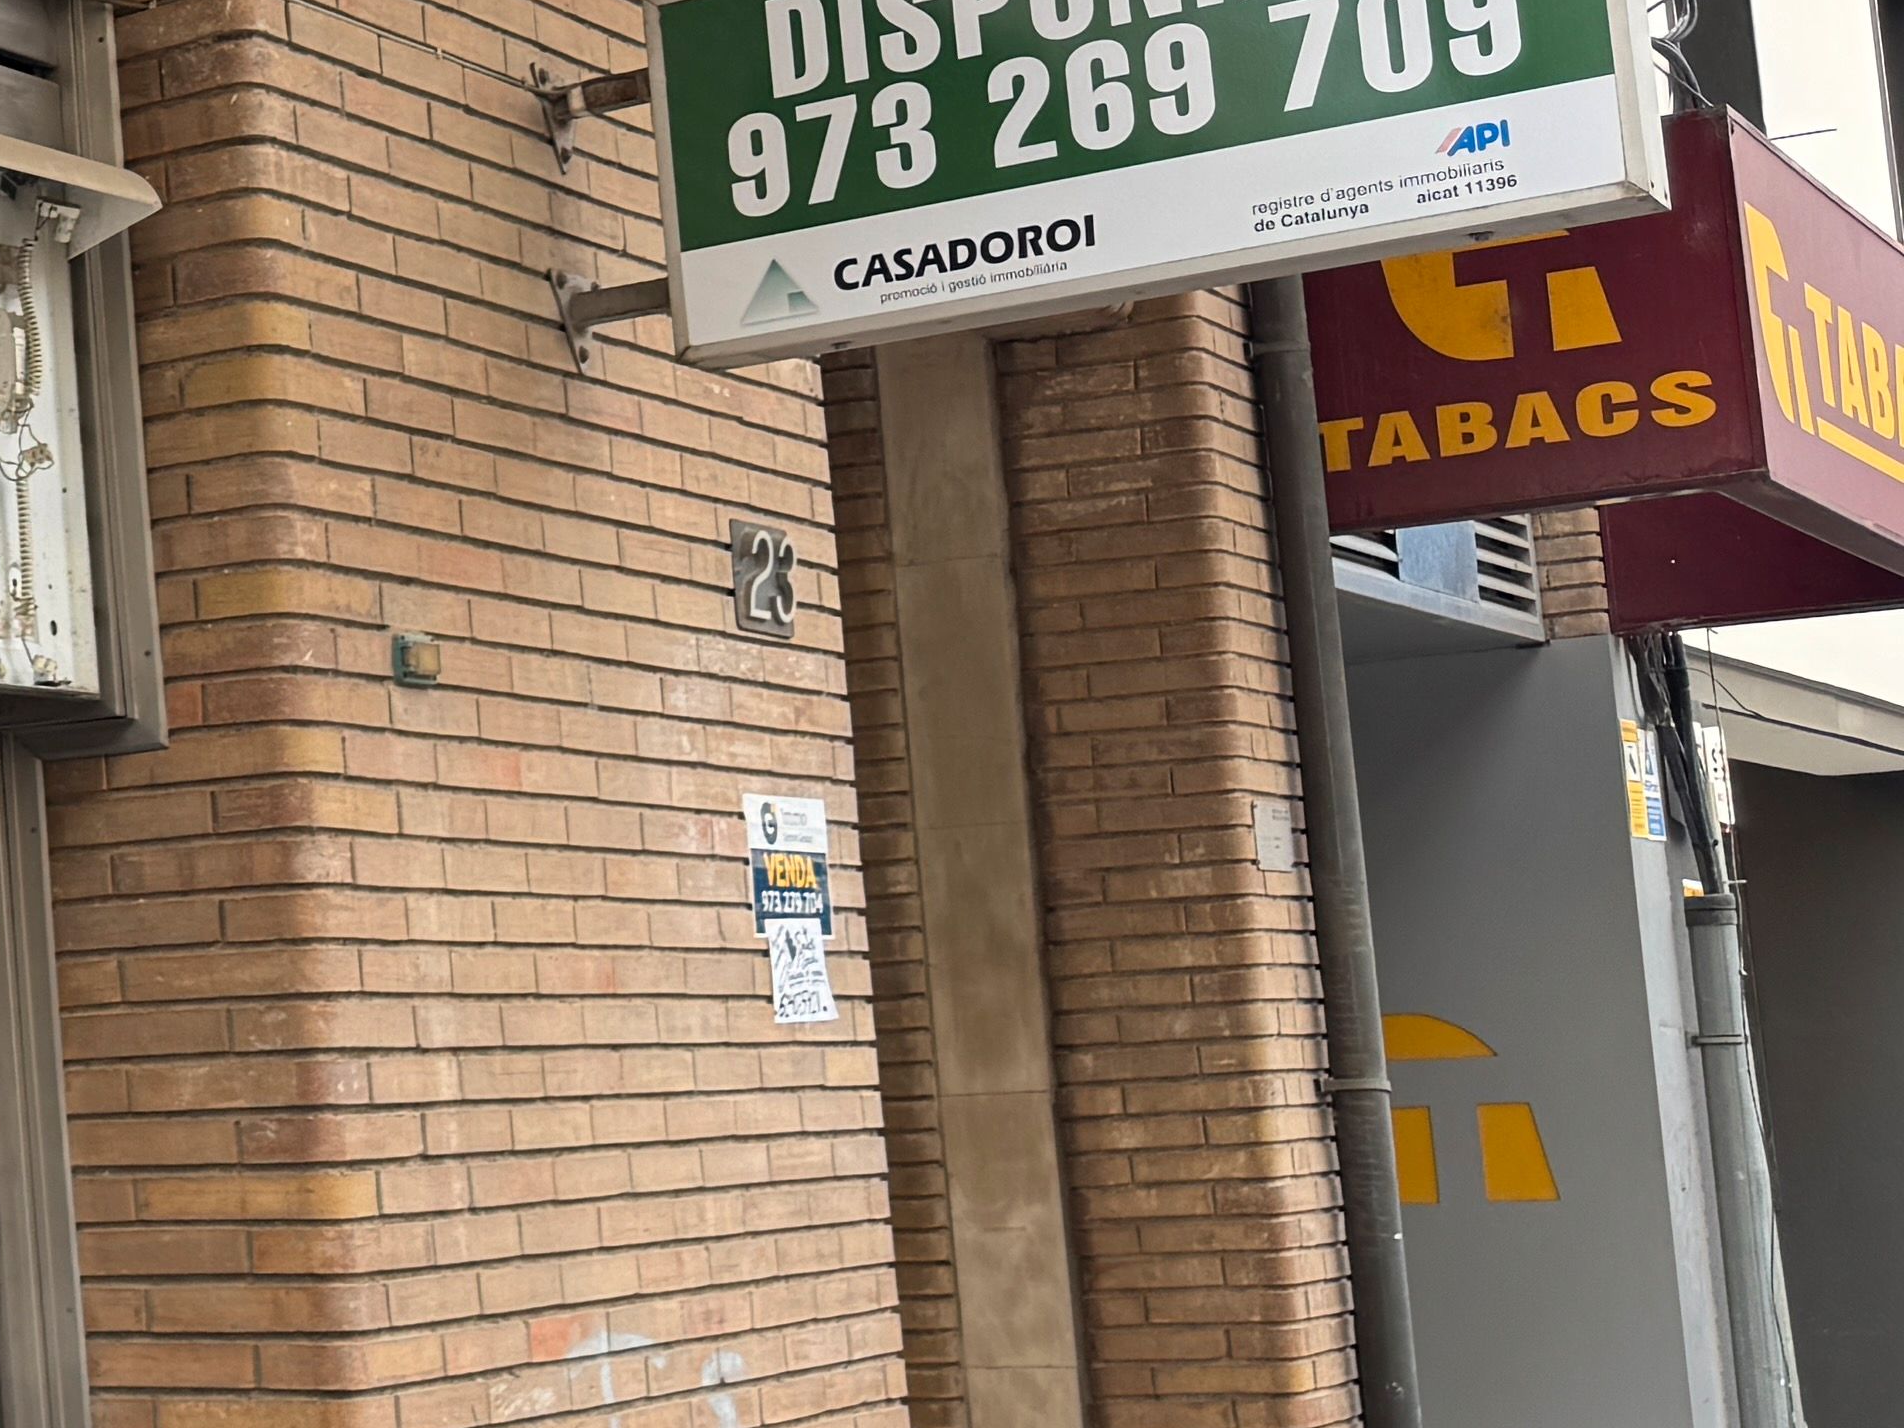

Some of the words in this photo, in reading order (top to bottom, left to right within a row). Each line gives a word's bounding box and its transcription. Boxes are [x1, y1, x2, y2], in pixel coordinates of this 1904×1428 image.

[728, 80, 936, 218] 973
[989, 23, 1216, 169] 269
[1447, 119, 1511, 157] API
[1252, 194, 1314, 217] registre
[1399, 160, 1505, 188] immobiliaris
[1254, 219, 1276, 232] de
[1281, 202, 1369, 229] Catalunya
[1417, 185, 1460, 204] aicat
[1464, 174, 1518, 196] 11396
[834, 214, 1096, 291] CASADOROI
[880, 282, 938, 305] promoció
[948, 273, 987, 293] gestió
[1804, 282, 1904, 448] TAB
[1317, 370, 1718, 472] TABACS
[749, 530, 798, 623] 23
[763, 853, 818, 889] VENDA
